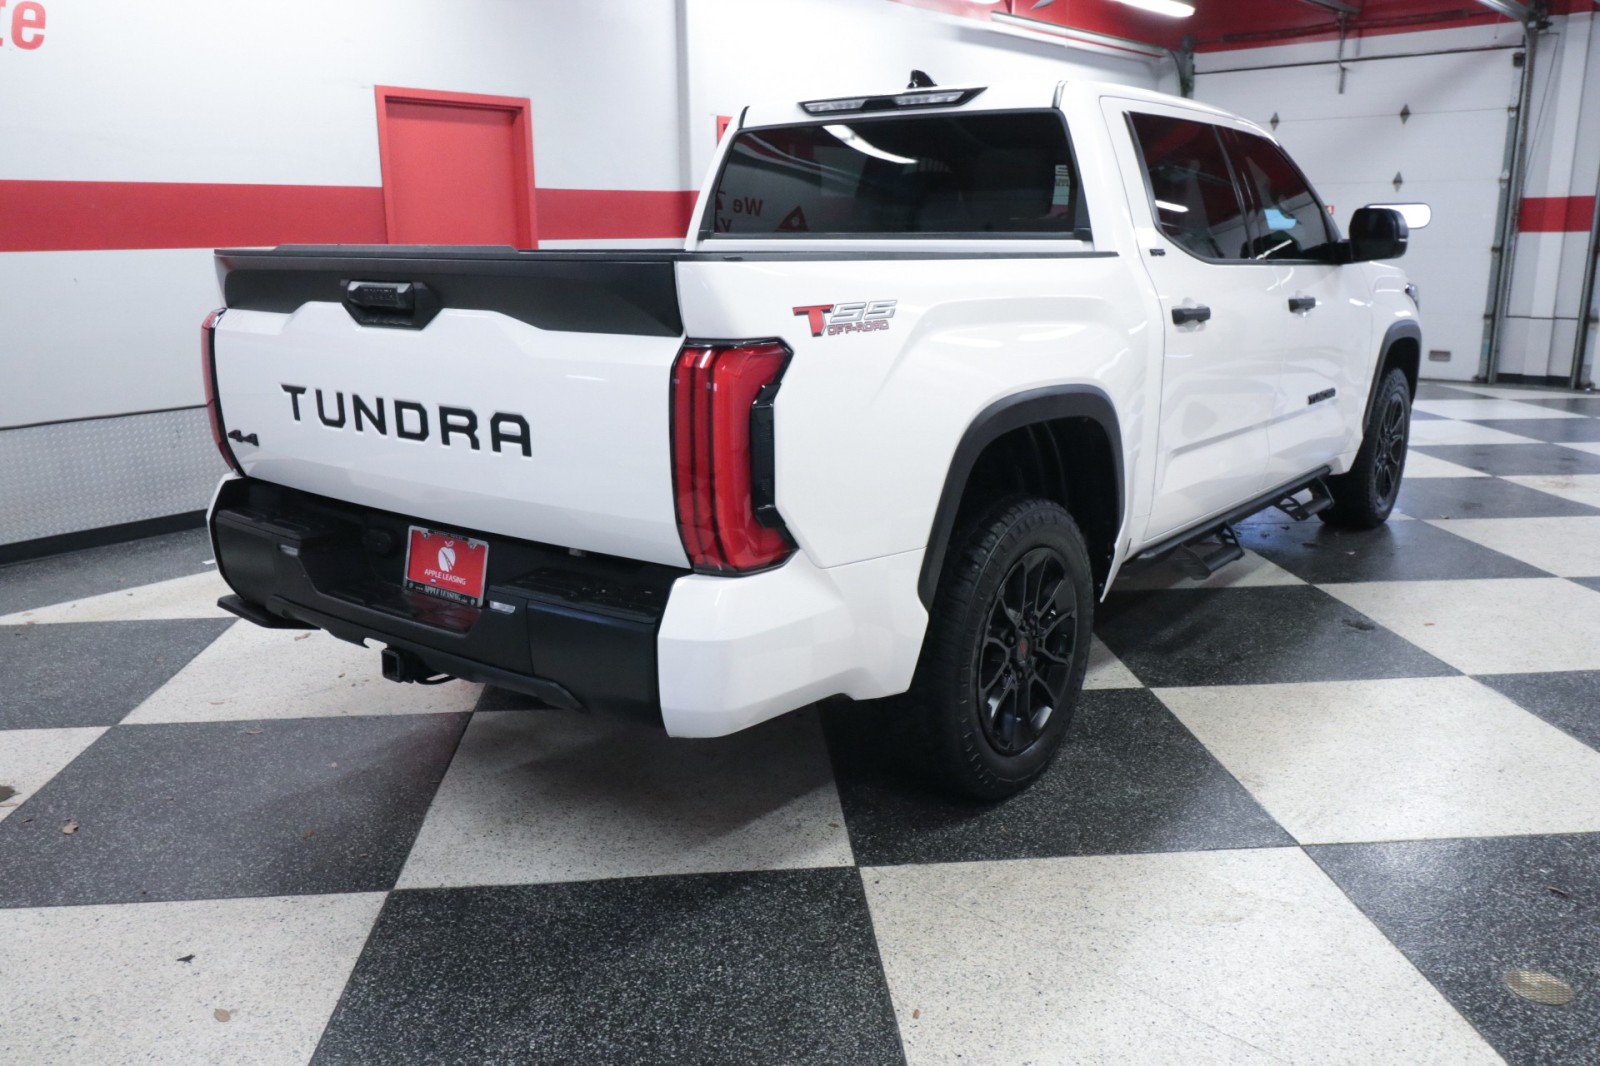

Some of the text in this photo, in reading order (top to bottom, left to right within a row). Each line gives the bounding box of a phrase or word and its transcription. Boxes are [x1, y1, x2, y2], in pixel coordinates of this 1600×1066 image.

[827, 319, 890, 336] OFF-ROAD
[280, 383, 533, 458] TUNDRA
[424, 568, 467, 585] APPLE LEASING
